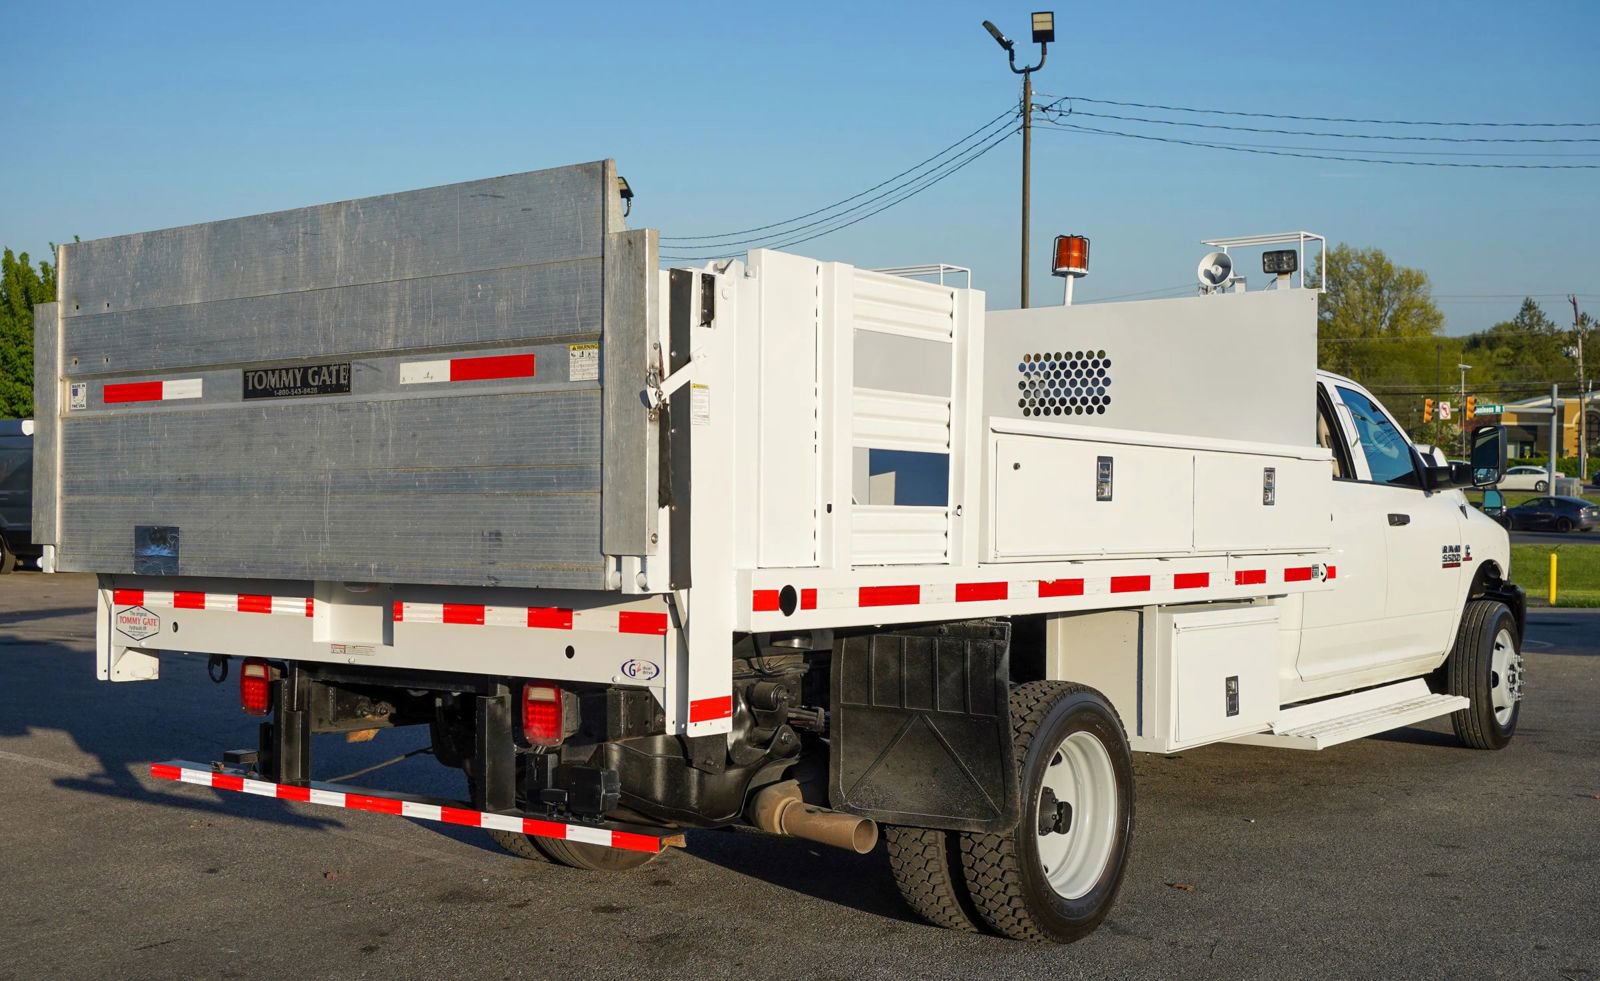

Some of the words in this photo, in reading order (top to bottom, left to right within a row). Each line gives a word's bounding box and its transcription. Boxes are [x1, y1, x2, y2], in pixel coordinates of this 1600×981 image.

[245, 367, 304, 391] TOMMY
[307, 362, 350, 387] GATE
[1442, 544, 1461, 553] RAM
[119, 616, 141, 625] TOMMY
[142, 617, 158, 627] GATE
